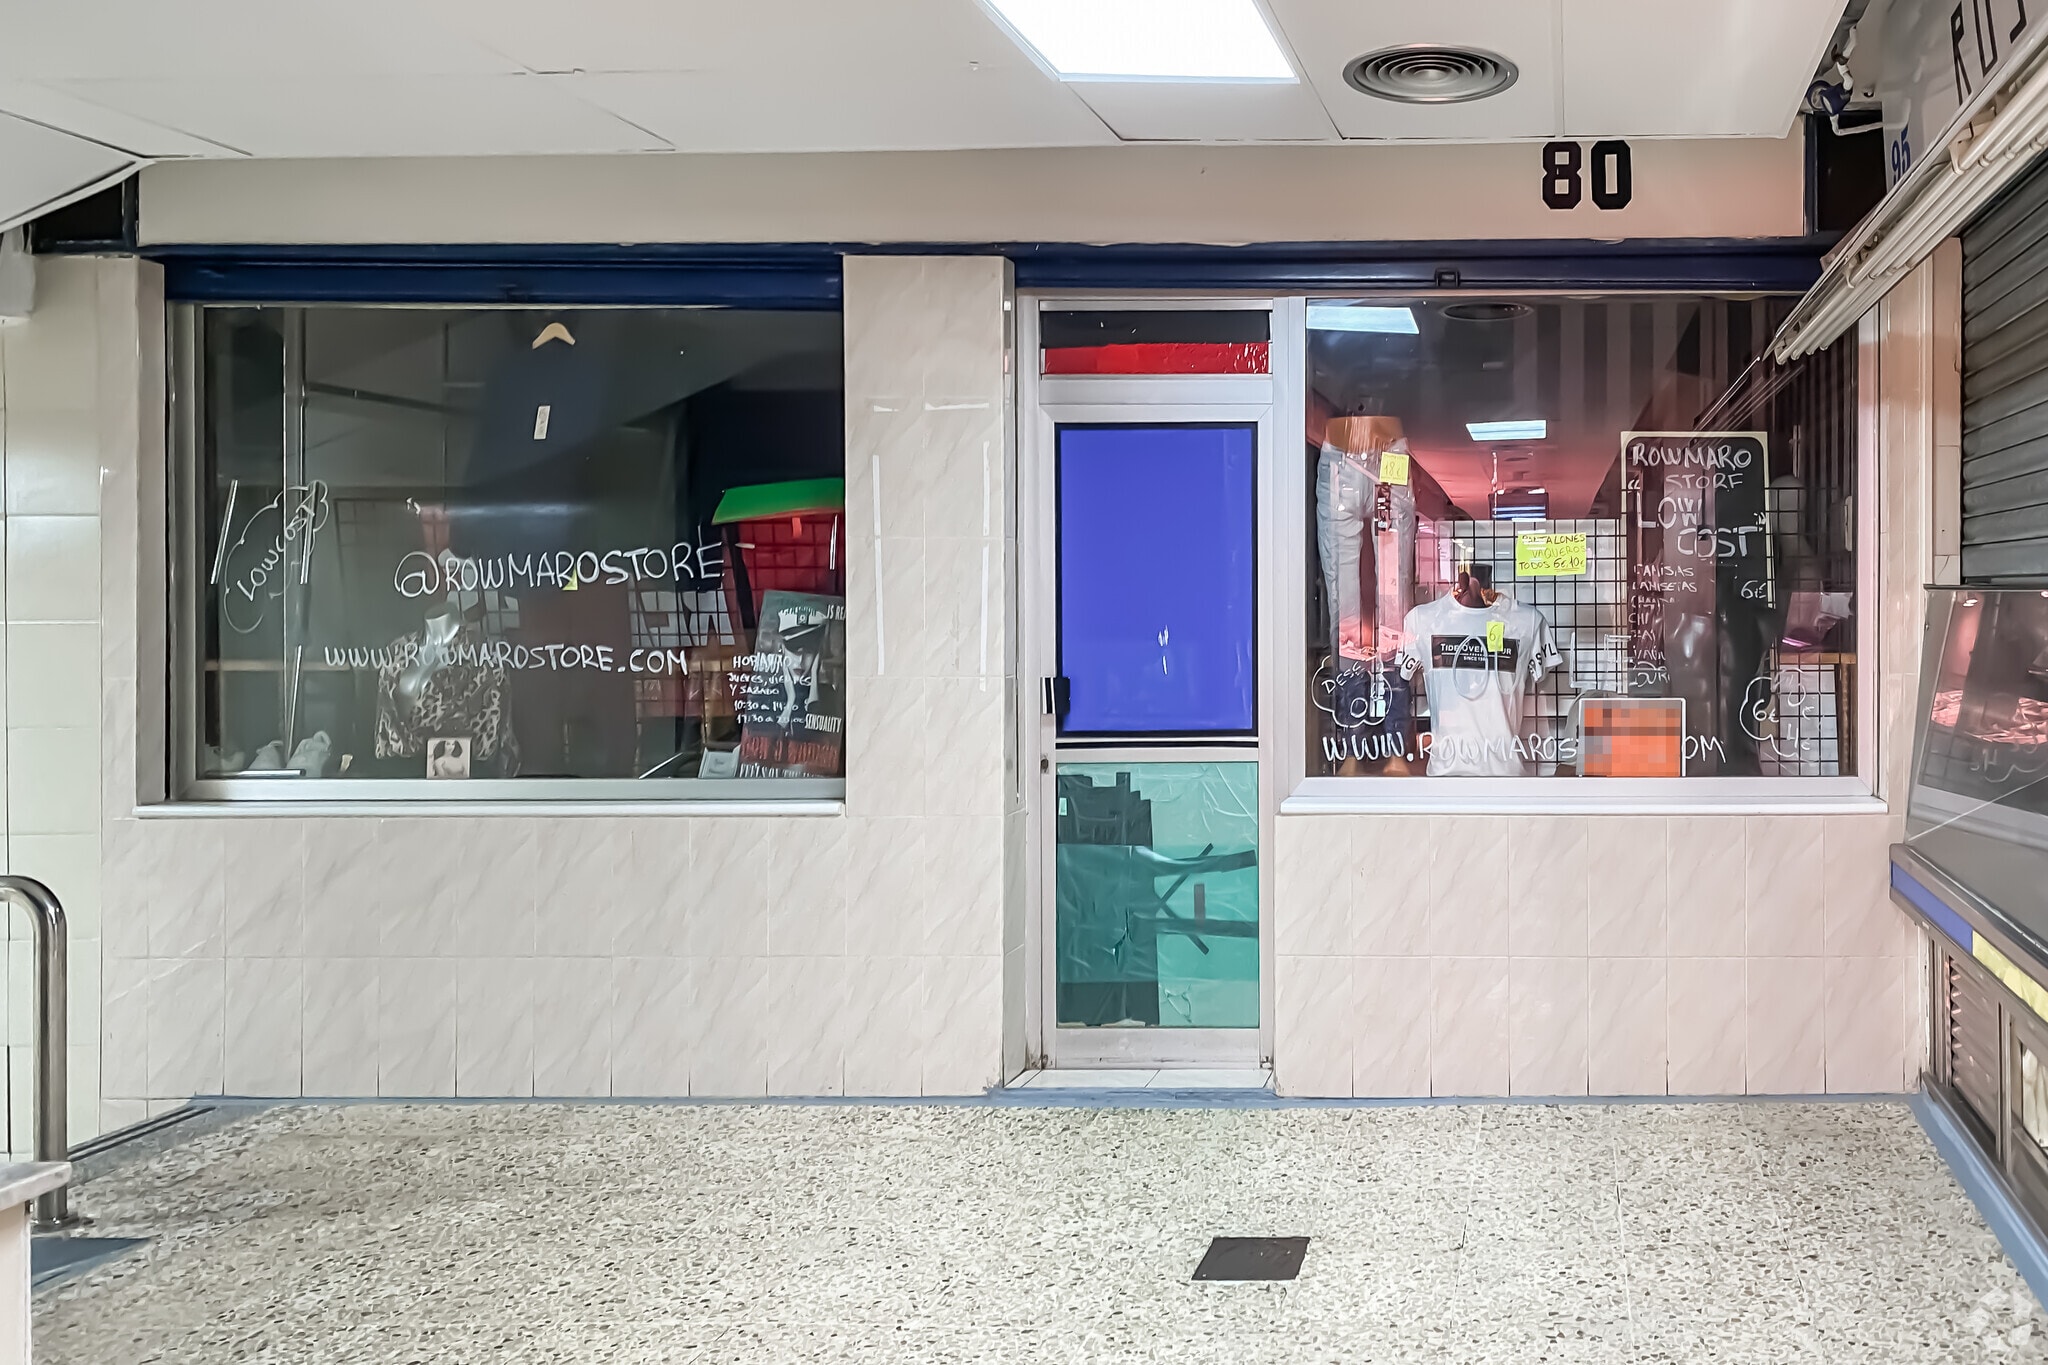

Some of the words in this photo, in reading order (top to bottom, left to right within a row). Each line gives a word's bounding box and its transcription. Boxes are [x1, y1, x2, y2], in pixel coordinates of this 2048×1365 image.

[1542, 140, 1632, 210] 80
[1632, 443, 1752, 471] ROWMARO
[394, 524, 725, 597] @ROWMAROSTORE
[1532, 545, 1585, 559] VAQUEROS
[1519, 561, 1550, 570] TODOS
[730, 684, 737, 696] Y
[804, 713, 842, 734] SENSUALITY
